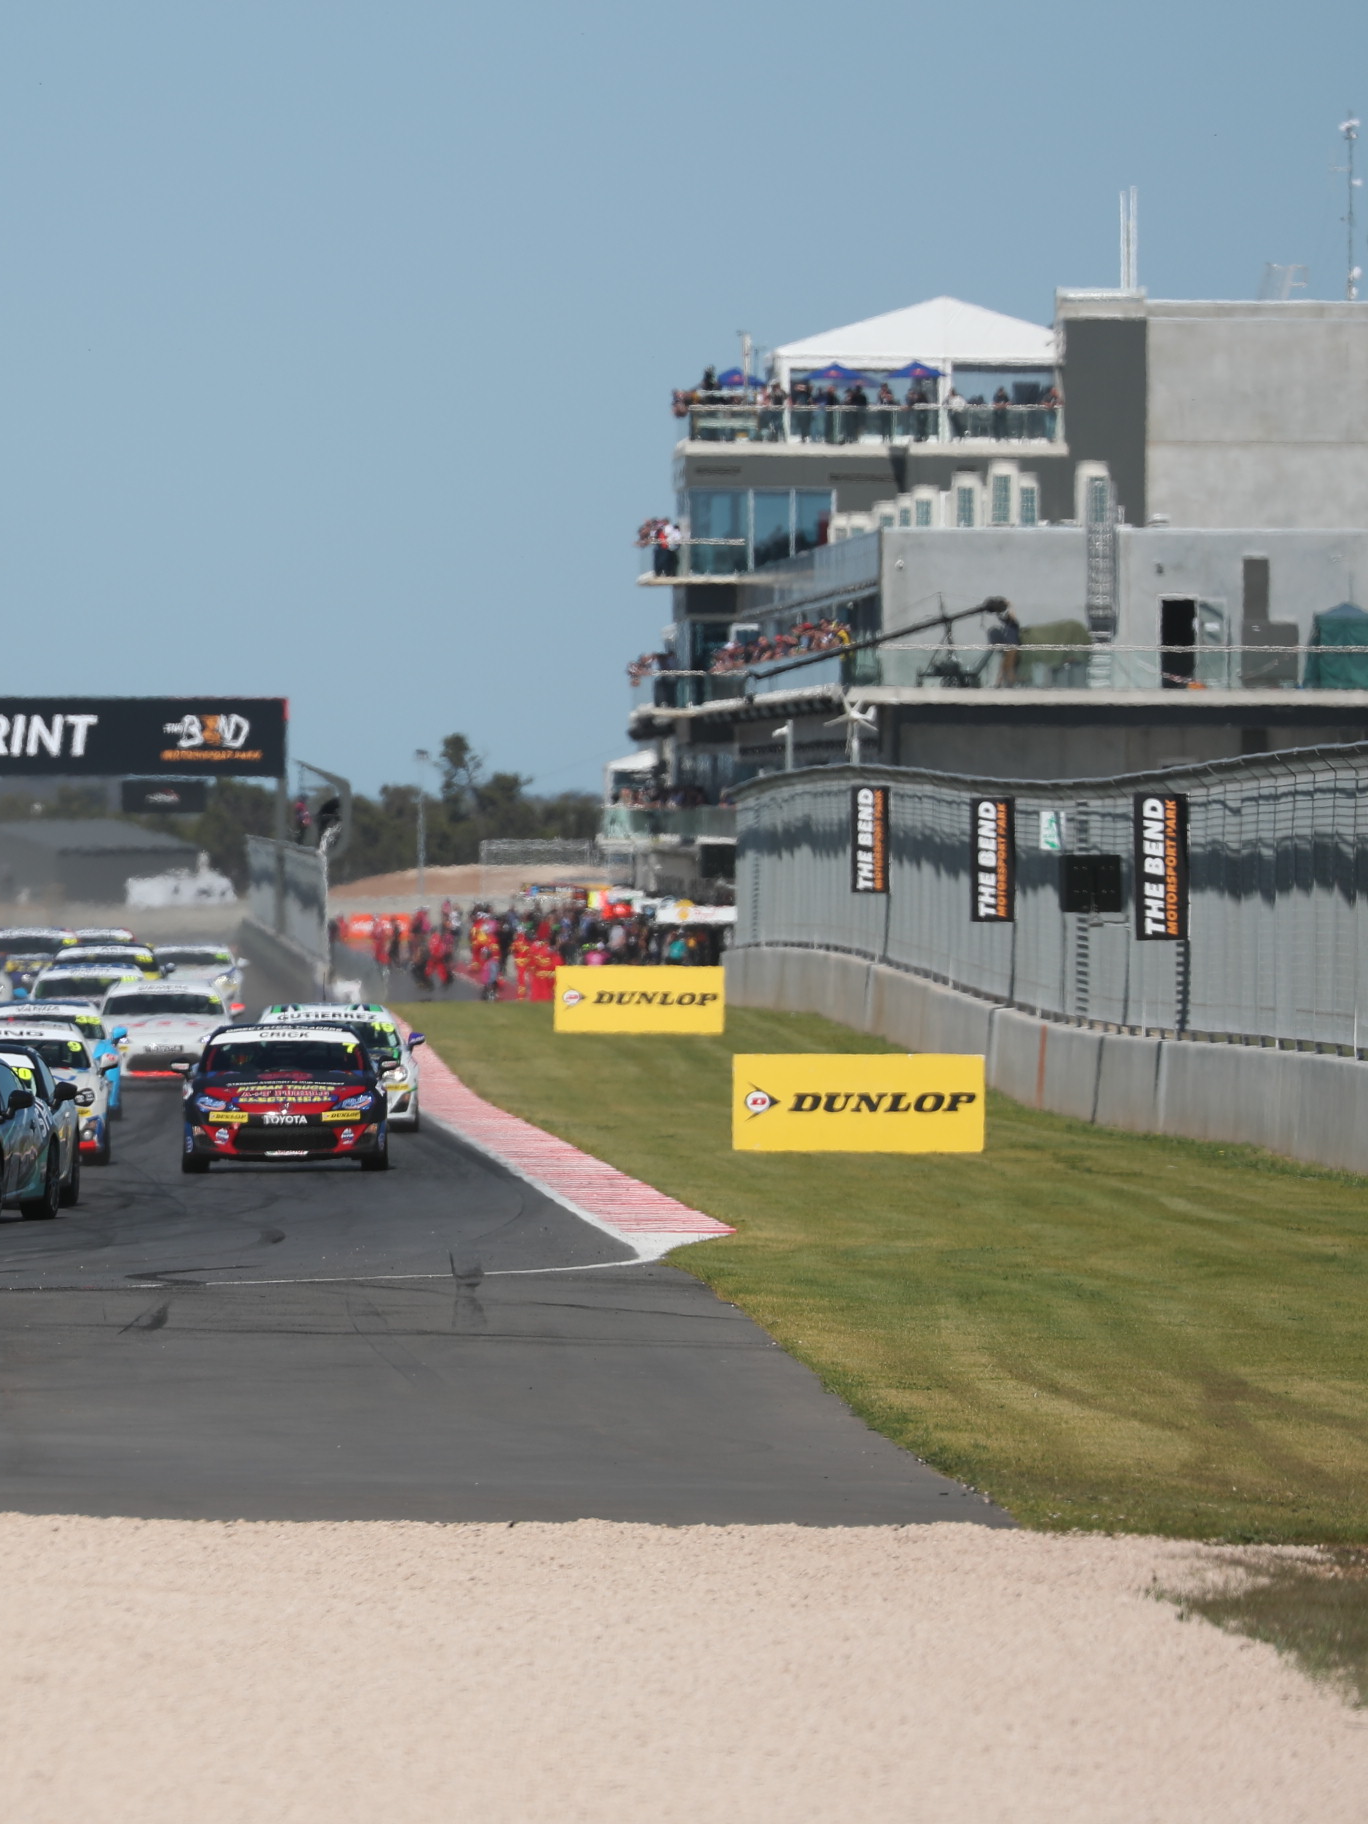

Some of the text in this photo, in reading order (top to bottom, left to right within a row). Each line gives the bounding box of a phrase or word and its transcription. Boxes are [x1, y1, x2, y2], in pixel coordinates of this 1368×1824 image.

[856, 788, 874, 891] THE BEND
[978, 801, 997, 918] THE BEND
[1143, 798, 1166, 935] THE BEND
[1165, 799, 1179, 936] MOTORSPORT PARK
[996, 837, 1007, 918] MOTORSPORT
[592, 990, 718, 1007] DUNLOP
[277, 1011, 378, 1021] GUTIERREZ
[259, 1031, 310, 1039] CRICK
[67, 1041, 82, 1052] 9
[341, 1042, 357, 1054] 7
[788, 1091, 977, 1113] DUNLOP
[263, 1114, 308, 1125] TOYOTA
